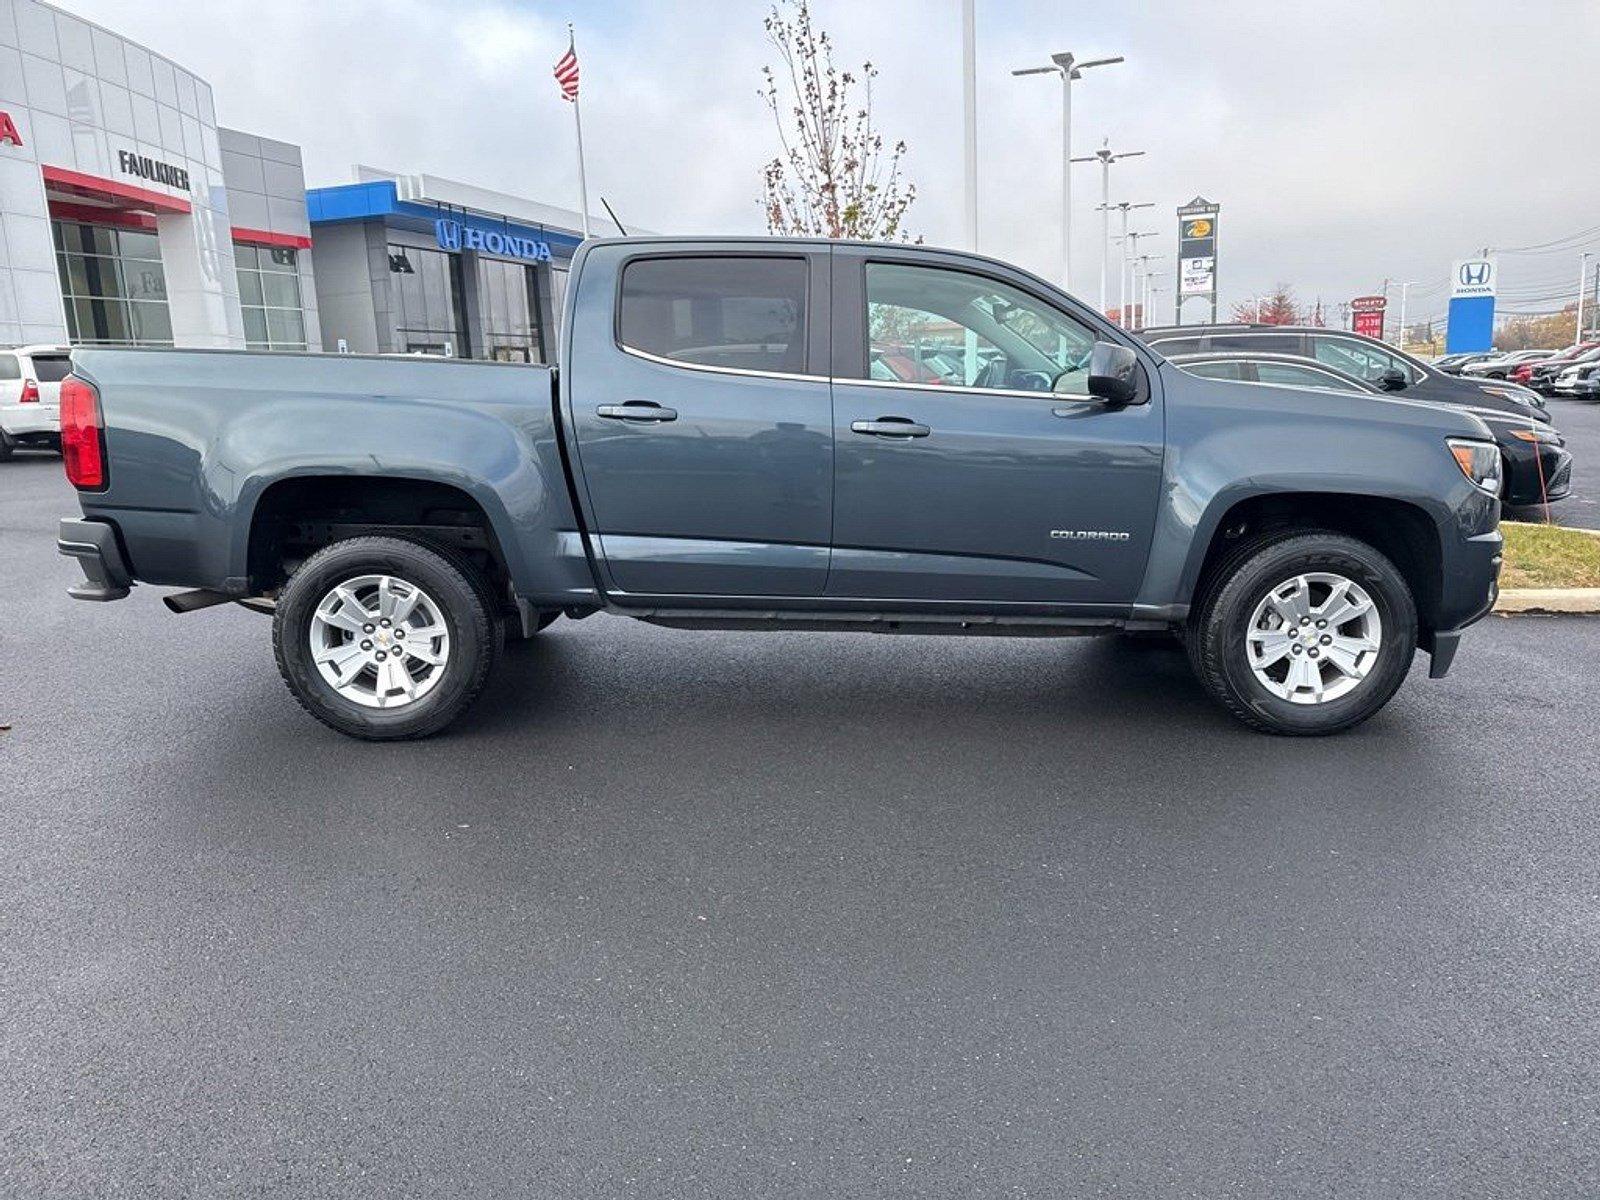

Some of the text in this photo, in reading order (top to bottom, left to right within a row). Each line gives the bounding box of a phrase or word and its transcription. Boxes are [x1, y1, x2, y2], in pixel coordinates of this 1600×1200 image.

[119, 150, 191, 191] FAULKNER
[462, 227, 552, 261] HONDA
[1049, 529, 1130, 540] COLORADO
